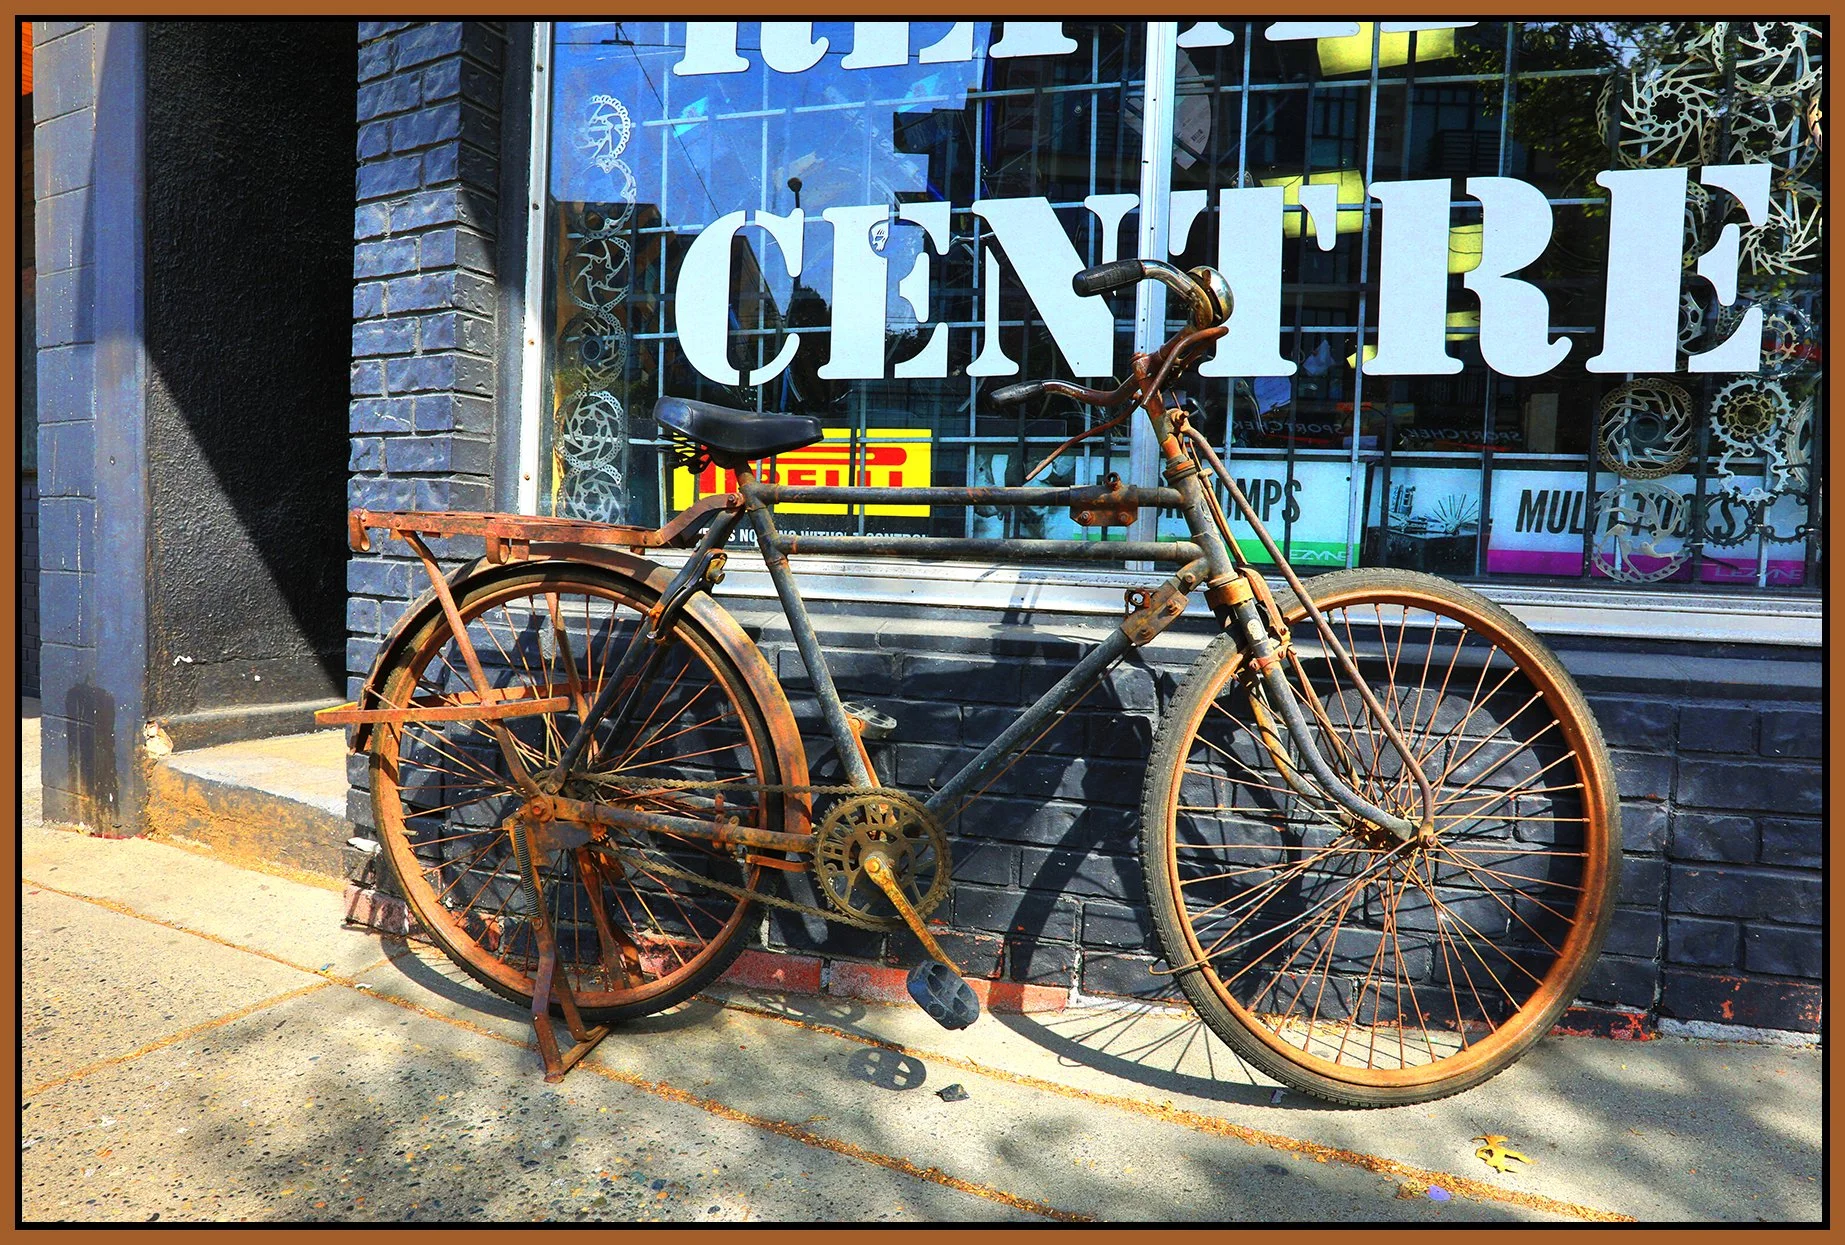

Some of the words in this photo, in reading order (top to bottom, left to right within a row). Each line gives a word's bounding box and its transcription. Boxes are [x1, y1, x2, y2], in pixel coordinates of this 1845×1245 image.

[674, 163, 1772, 387] CENTRE
[1214, 477, 1302, 524] UMPS
[1631, 490, 1743, 541] TOOS
[1291, 548, 1348, 563] EZYNE
